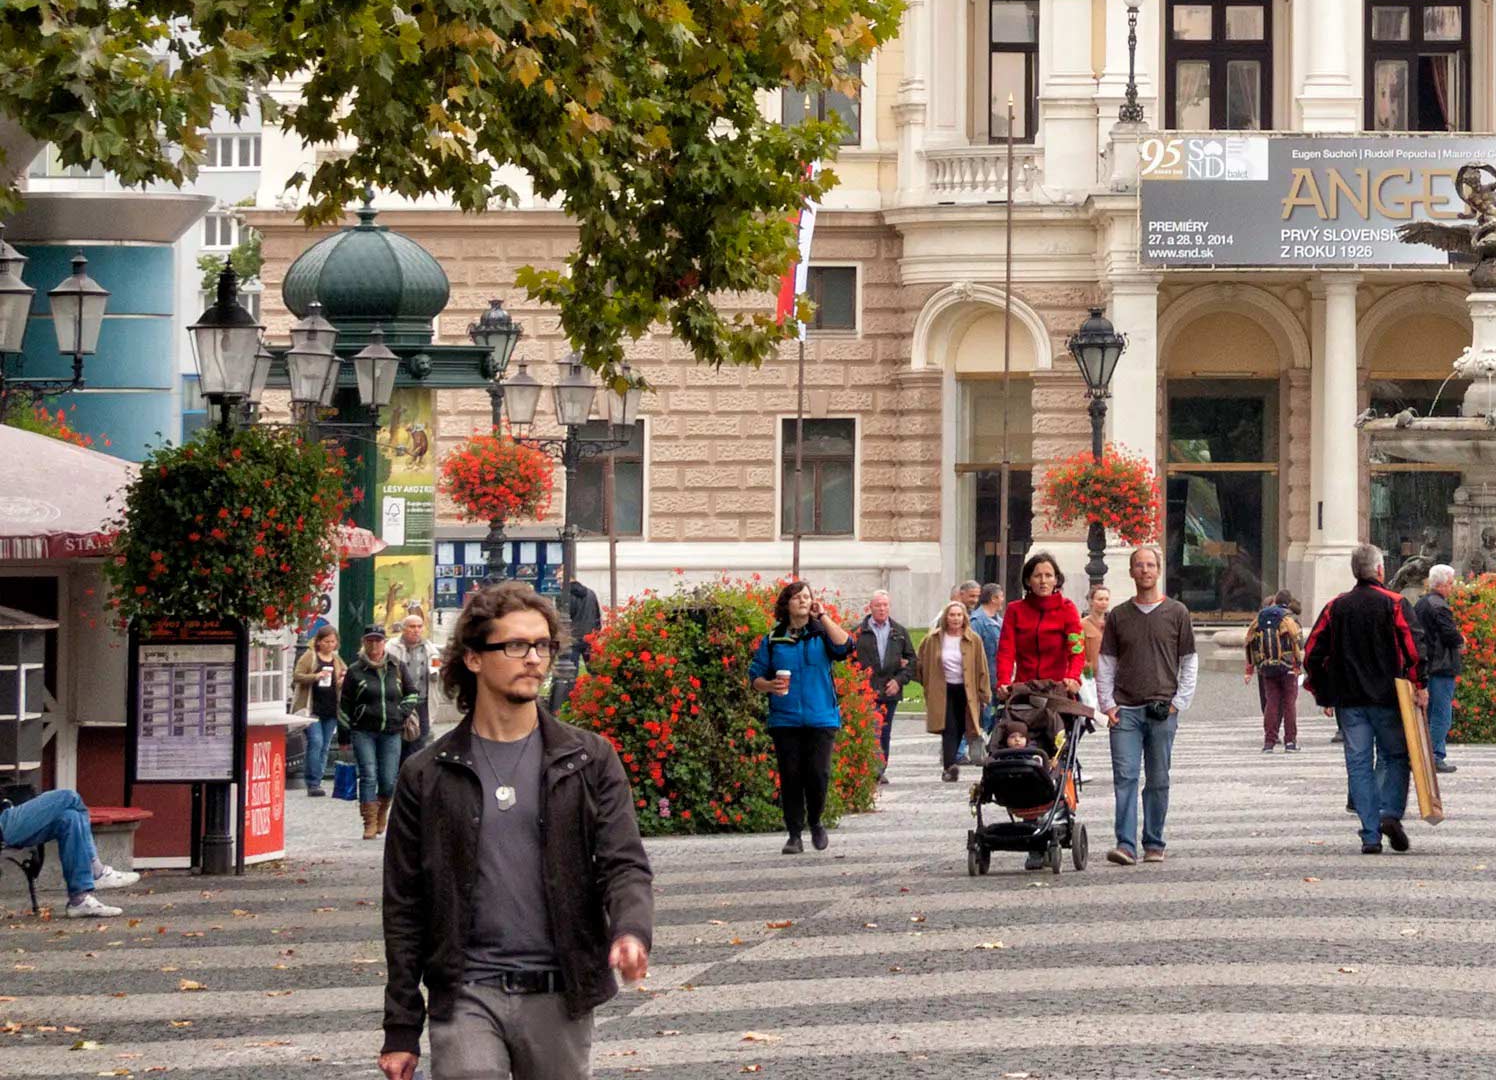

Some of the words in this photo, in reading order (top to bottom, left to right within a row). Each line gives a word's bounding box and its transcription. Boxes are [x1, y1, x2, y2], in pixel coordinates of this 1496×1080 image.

[1141, 139, 1185, 176] 95
[1292, 149, 1321, 160] Eugen
[1149, 219, 1209, 232] PREMIÉRY
[1281, 226, 1320, 241] PRVÝ
[1323, 229, 1400, 241] SLOVENSK
[1149, 235, 1165, 245] 27.
[1167, 237, 1175, 245] a
[1177, 235, 1193, 245] 28.
[1196, 235, 1206, 245] 9.
[1208, 235, 1234, 245] 2014
[1149, 248, 1214, 258] www.snd.sk
[1281, 246, 1290, 258] Z
[1294, 246, 1336, 258] ROKU
[1340, 246, 1373, 258] 1926
